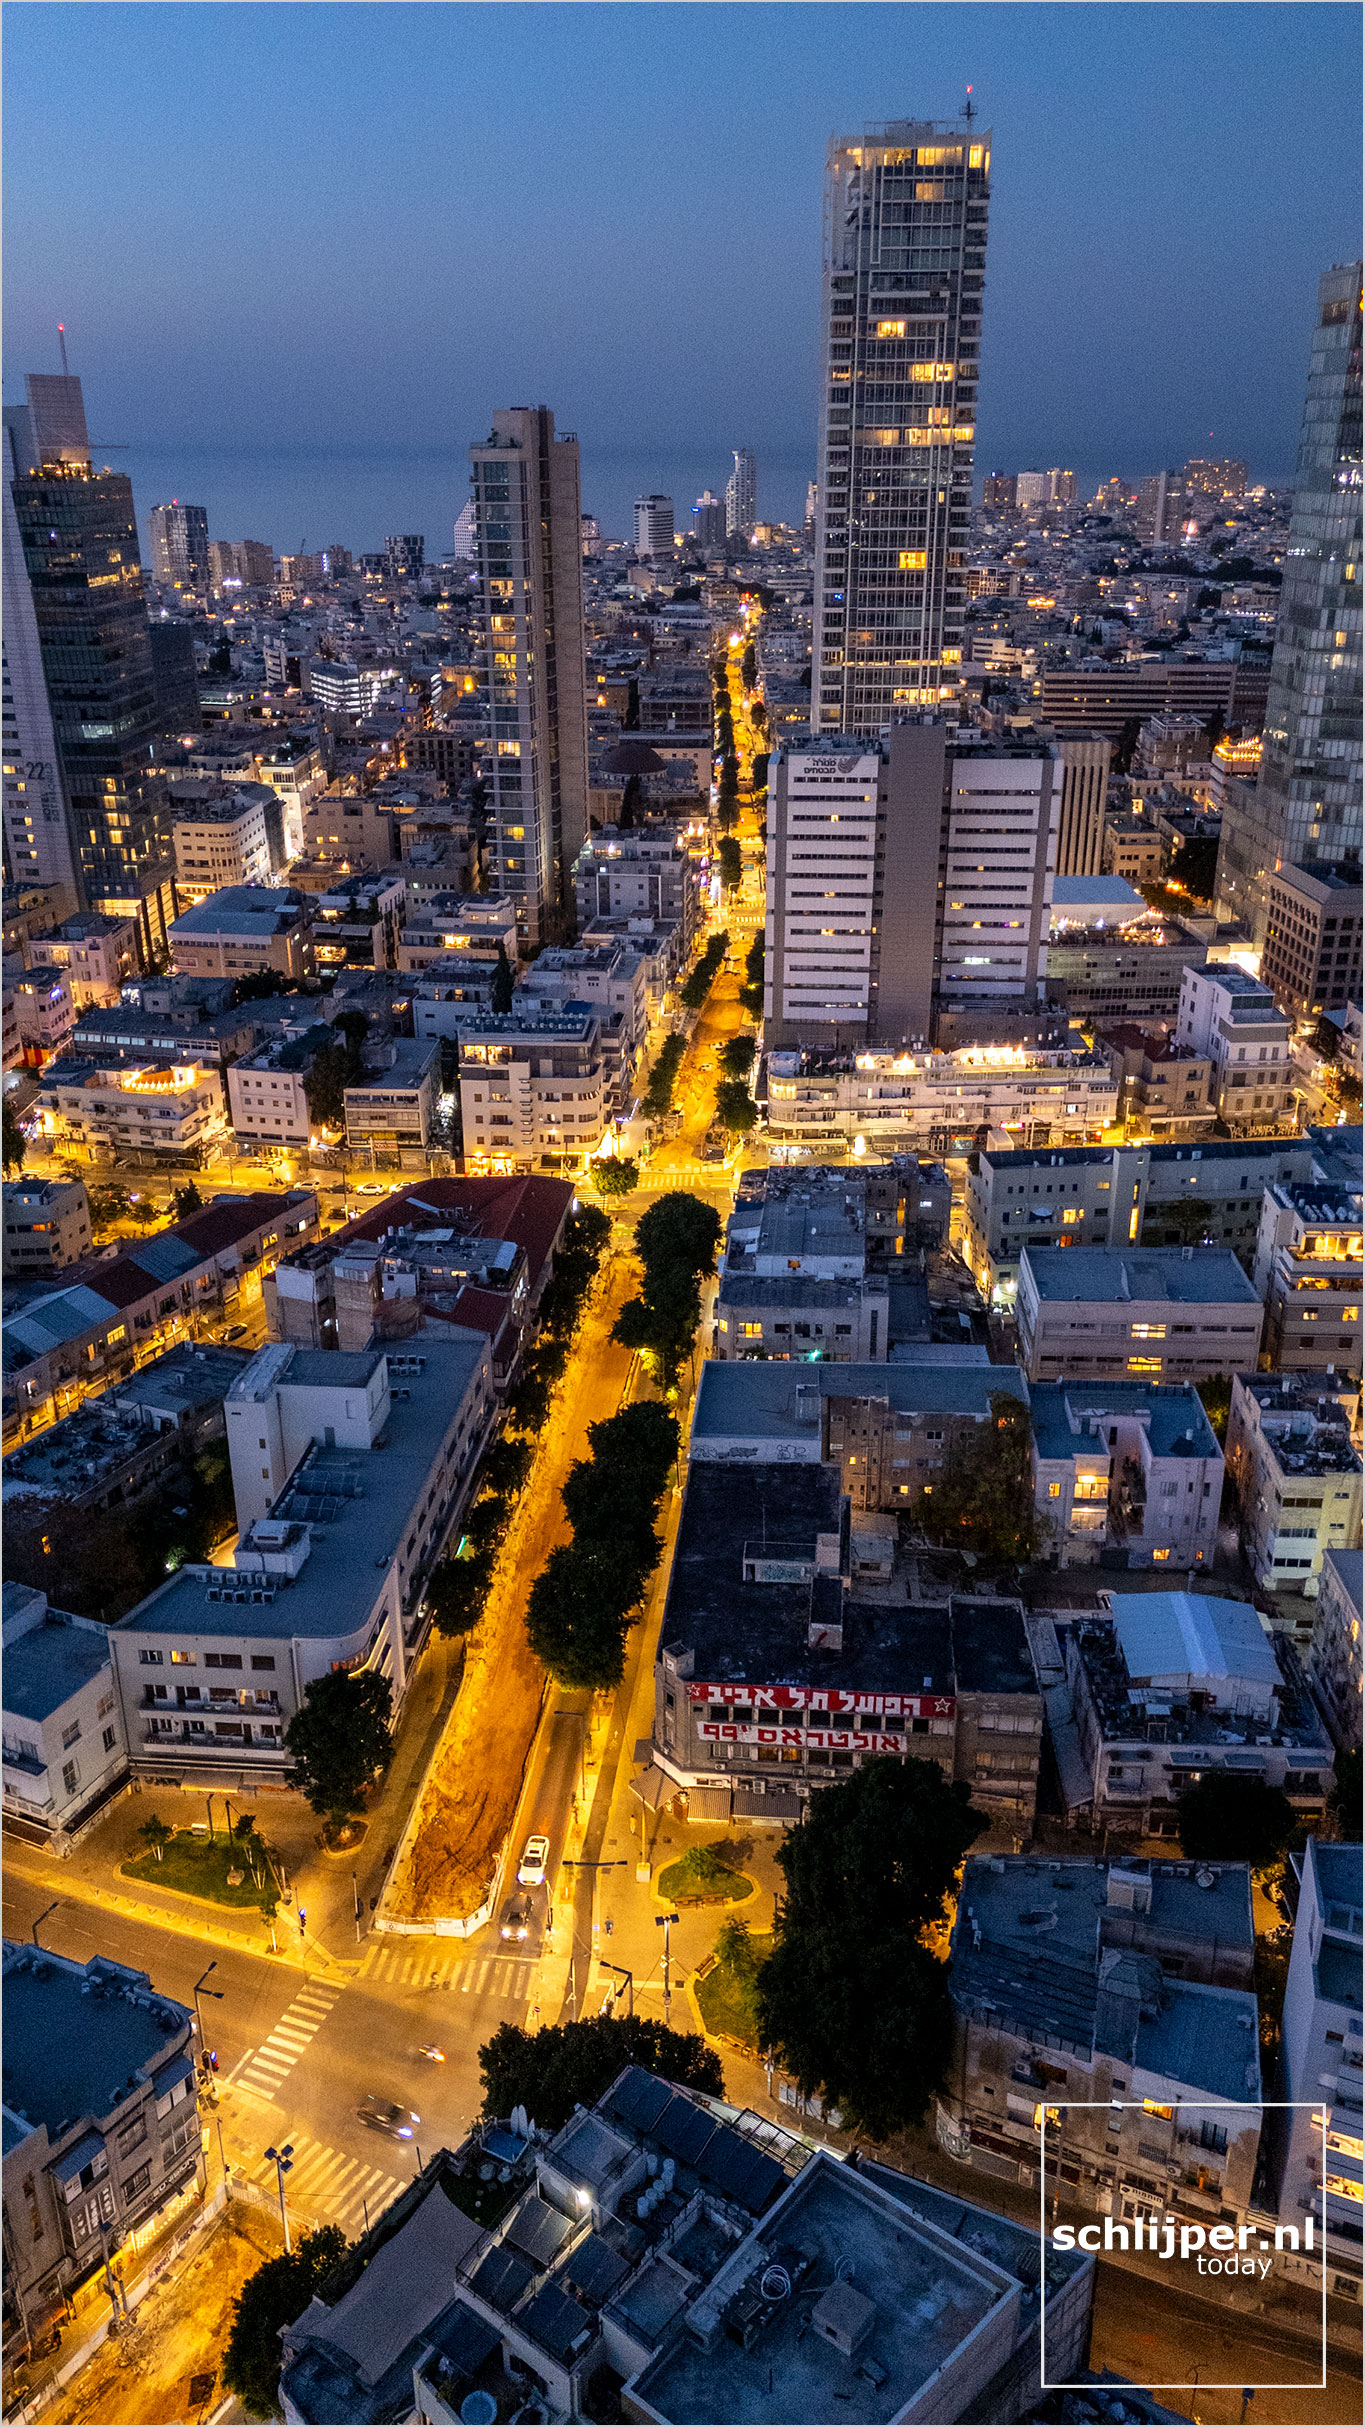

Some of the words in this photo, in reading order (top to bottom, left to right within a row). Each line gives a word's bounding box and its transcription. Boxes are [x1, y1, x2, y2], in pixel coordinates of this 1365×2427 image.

[26, 761, 45, 780] 22
[707, 1685, 777, 1708] אביב
[789, 1687, 829, 1710] תל
[839, 1690, 921, 1716] הפועל
[757, 1728, 901, 1751] אולטראס
